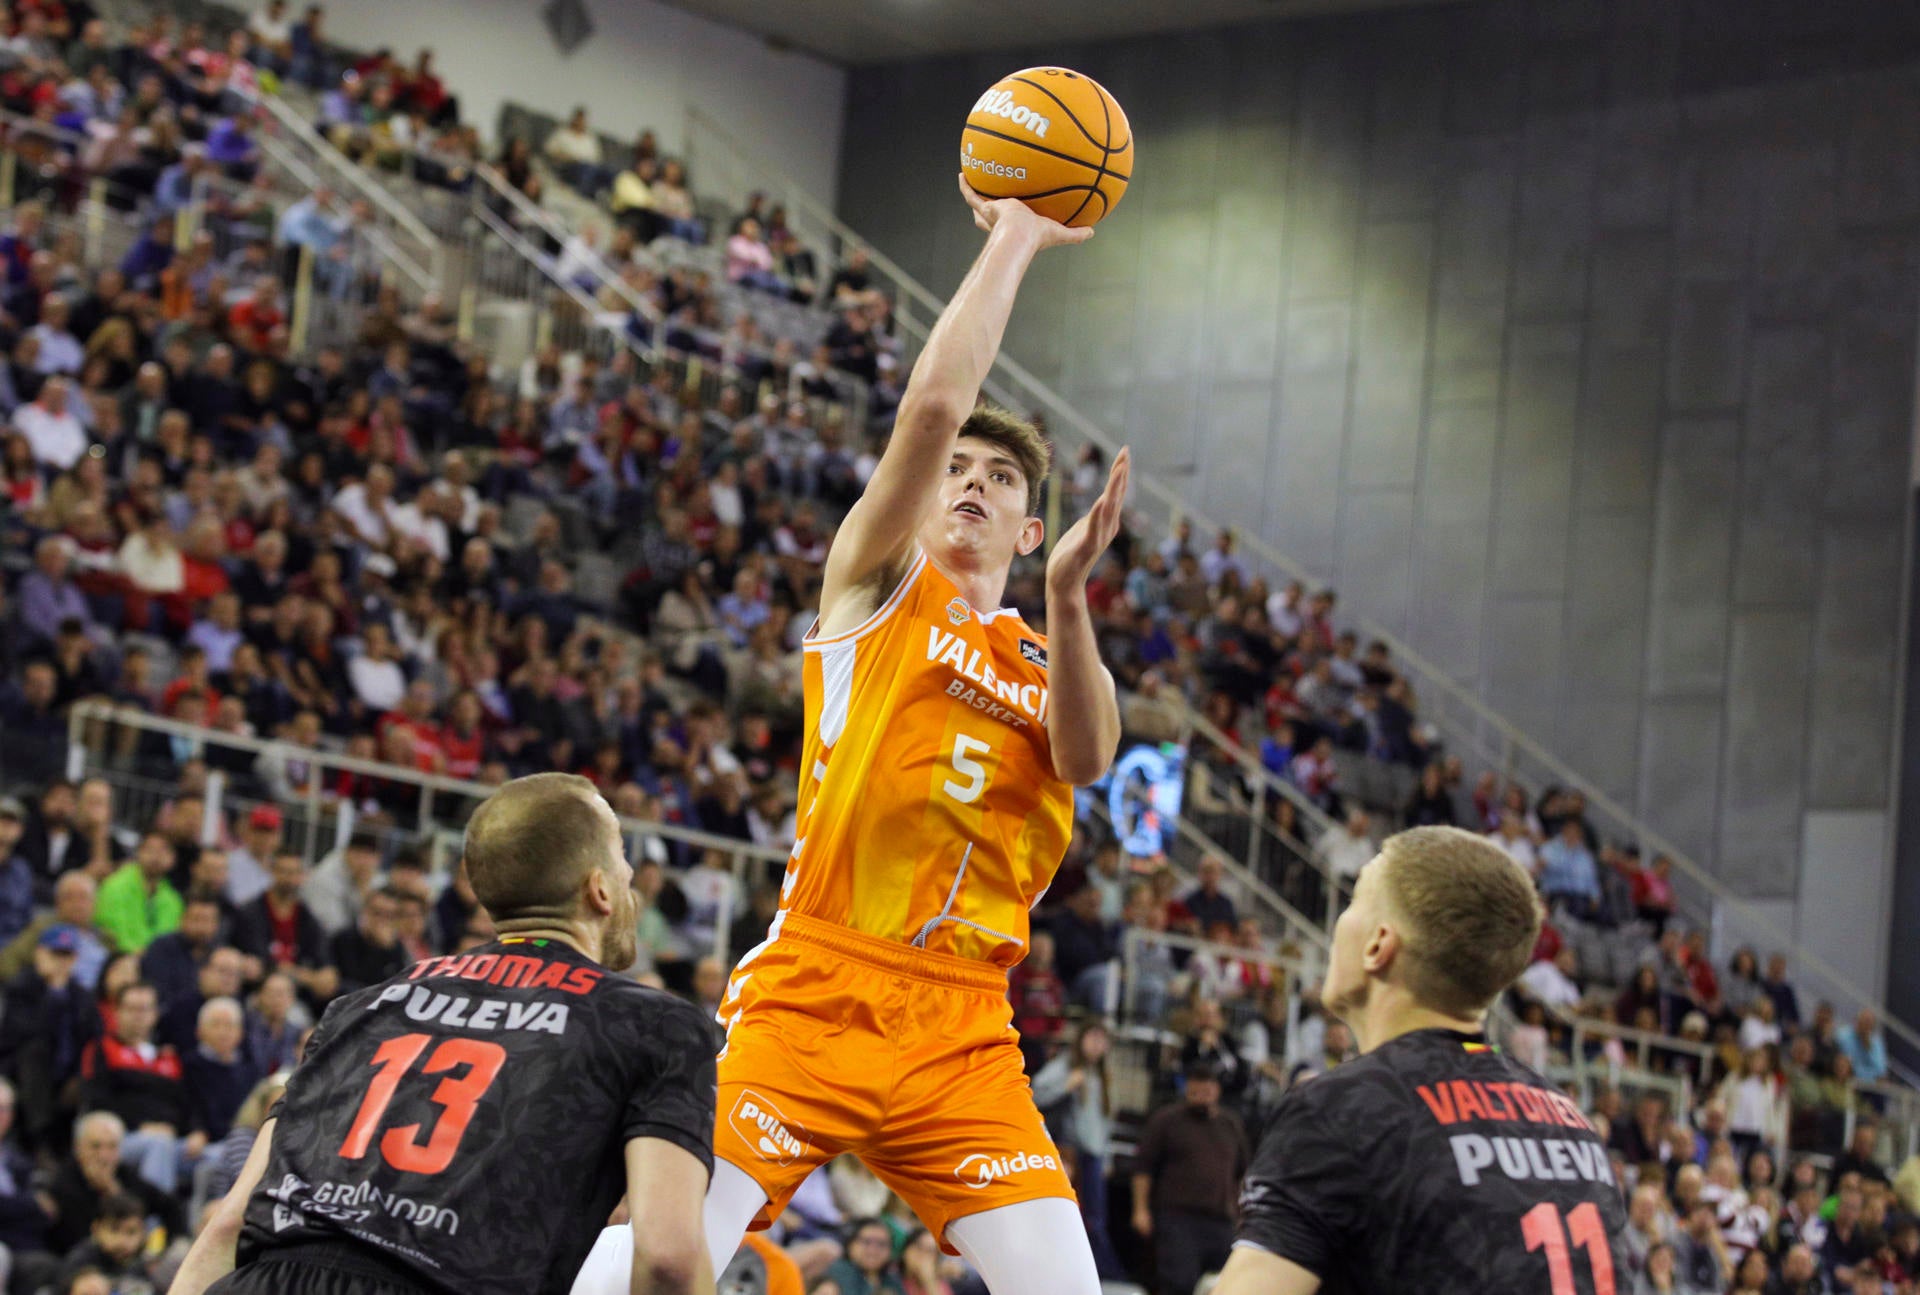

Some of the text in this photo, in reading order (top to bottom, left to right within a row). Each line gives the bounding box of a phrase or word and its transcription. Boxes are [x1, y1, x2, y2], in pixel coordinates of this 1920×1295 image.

[971, 158, 1026, 179] endesa
[926, 626, 1048, 728] VALENCI
[945, 678, 1028, 727] BASKET
[943, 733, 991, 803] 5
[408, 954, 605, 995] THOMAS
[366, 983, 570, 1034] PULEVA
[338, 1032, 507, 1175] 13
[739, 1101, 803, 1159] PULEVA
[978, 1152, 1057, 1182] Midea
[1450, 1133, 1614, 1187] PULEVA
[1520, 1202, 1617, 1295] 11
